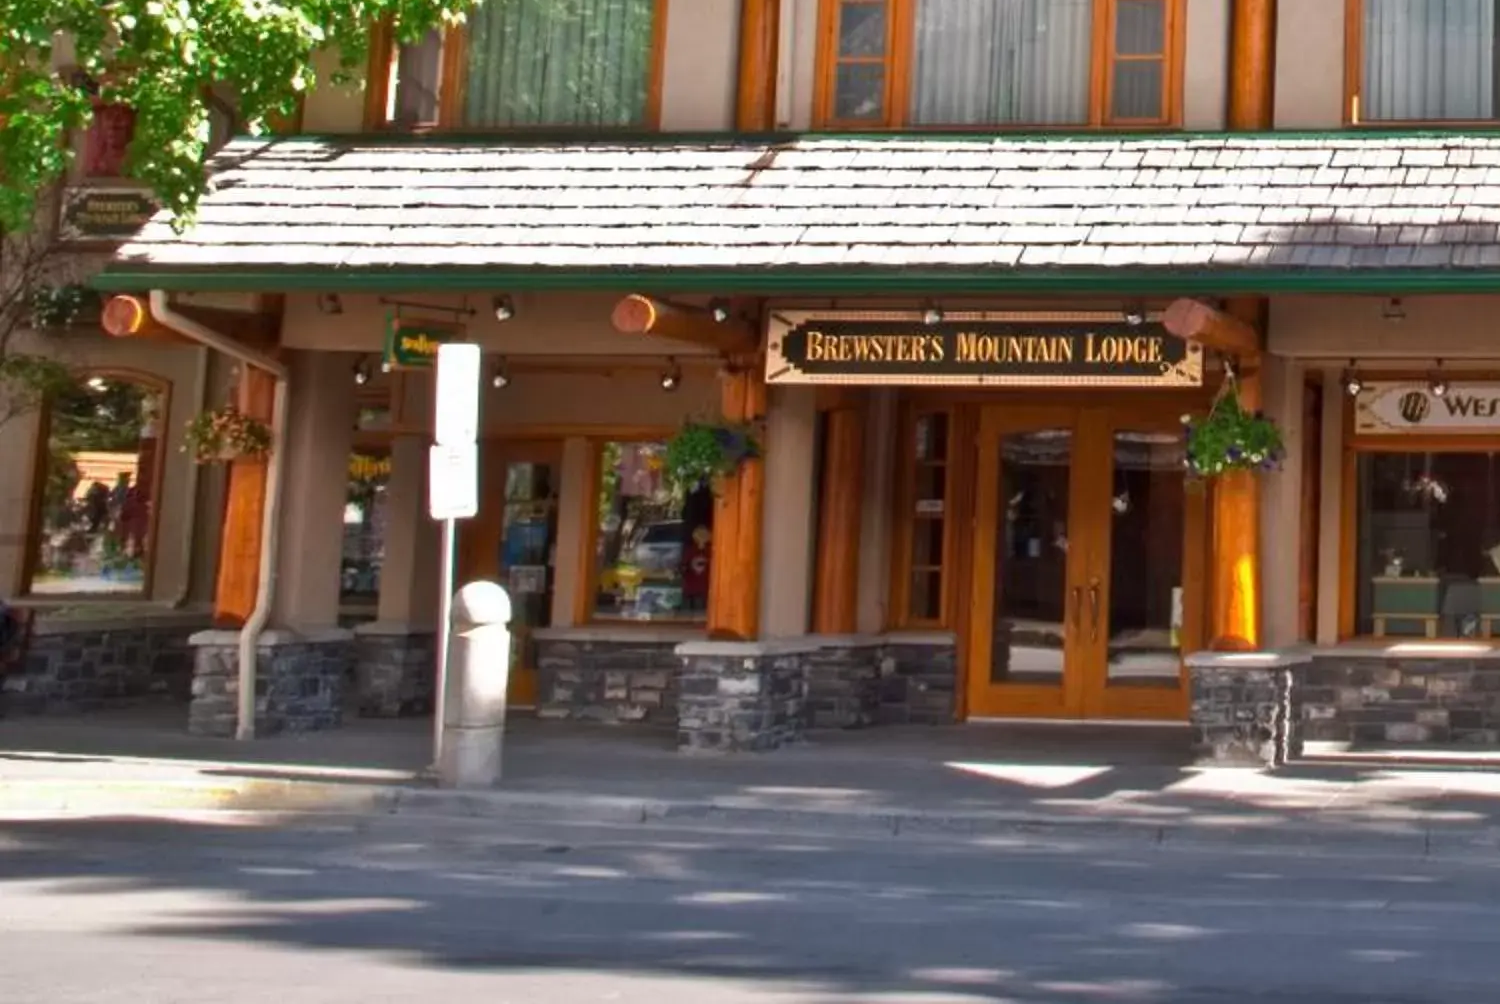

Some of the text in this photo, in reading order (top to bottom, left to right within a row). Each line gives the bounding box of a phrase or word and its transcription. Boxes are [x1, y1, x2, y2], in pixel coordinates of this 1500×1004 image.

[806, 331, 1163, 364] BREWSTER'S MOUNTAIN LODGE
